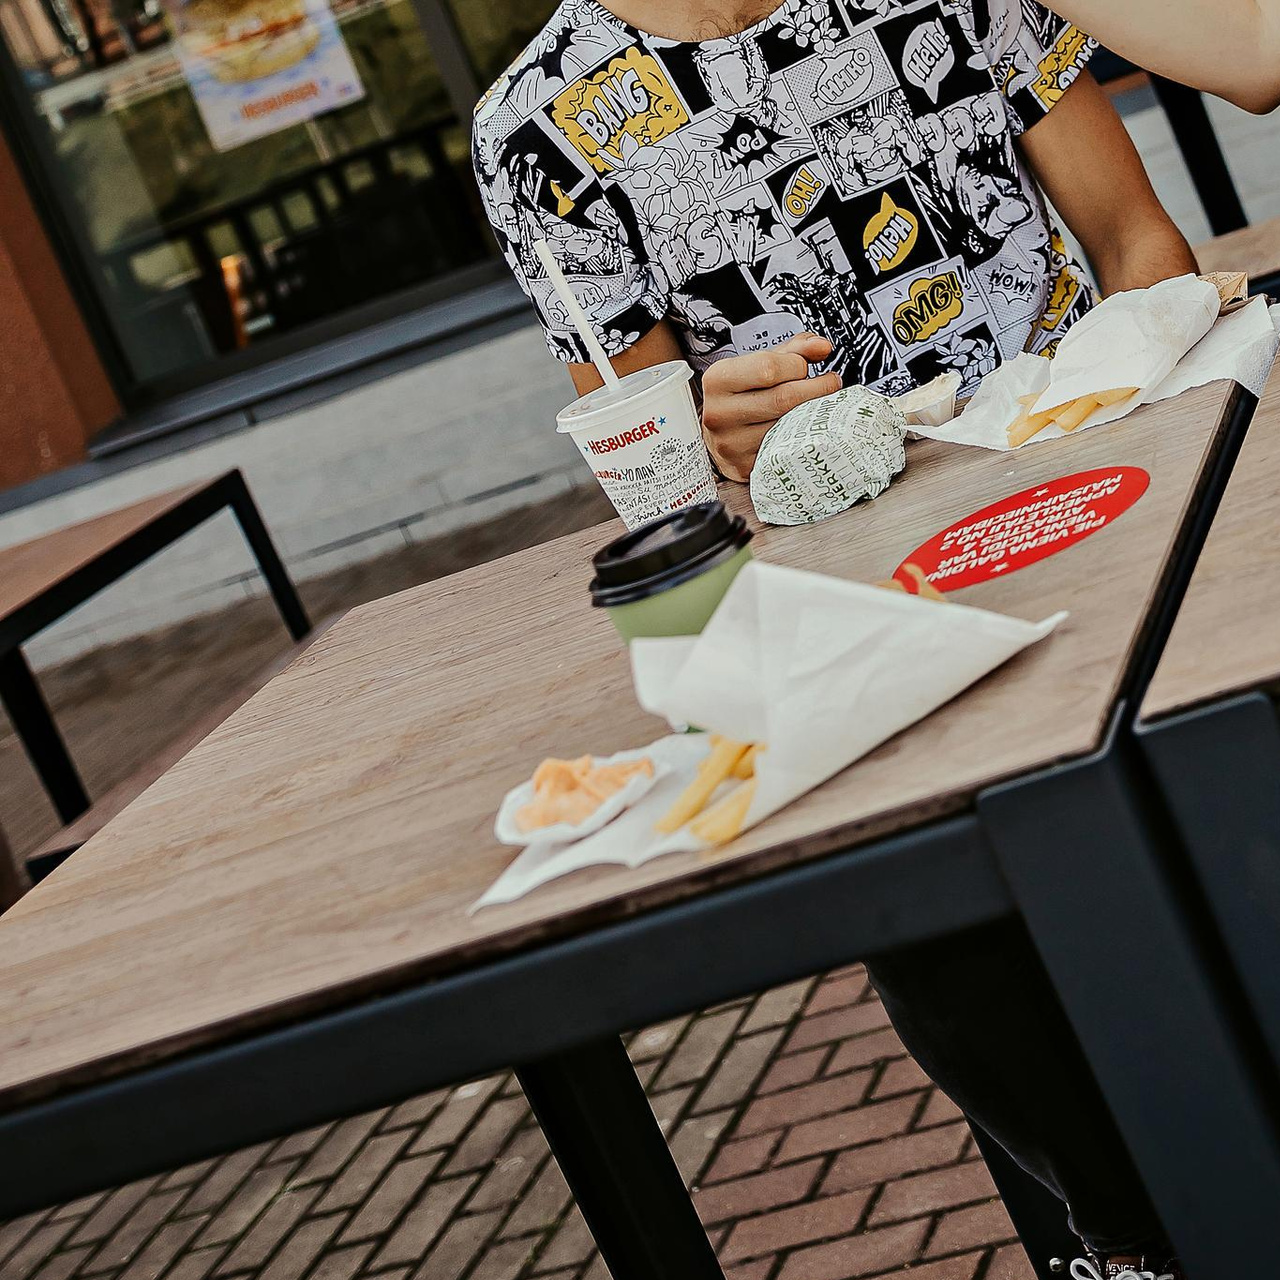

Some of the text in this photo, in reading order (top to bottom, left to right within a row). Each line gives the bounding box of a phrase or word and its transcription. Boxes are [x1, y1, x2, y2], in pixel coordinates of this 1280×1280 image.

[907, 20, 951, 83] Hello!
[575, 68, 650, 147] BANG
[711, 127, 768, 179] POW!
[786, 166, 819, 217] OH!
[864, 212, 913, 269] Hello!
[989, 269, 1038, 299] WOW!
[587, 420, 660, 456] HESBURGER
[957, 530, 988, 545] NO
[961, 504, 1087, 553] ATRASTIES 4
[1010, 527, 1070, 556] VIENA
[1072, 514, 1107, 535] PIE
[937, 548, 978, 571] VAR
[939, 541, 955, 552] 2
